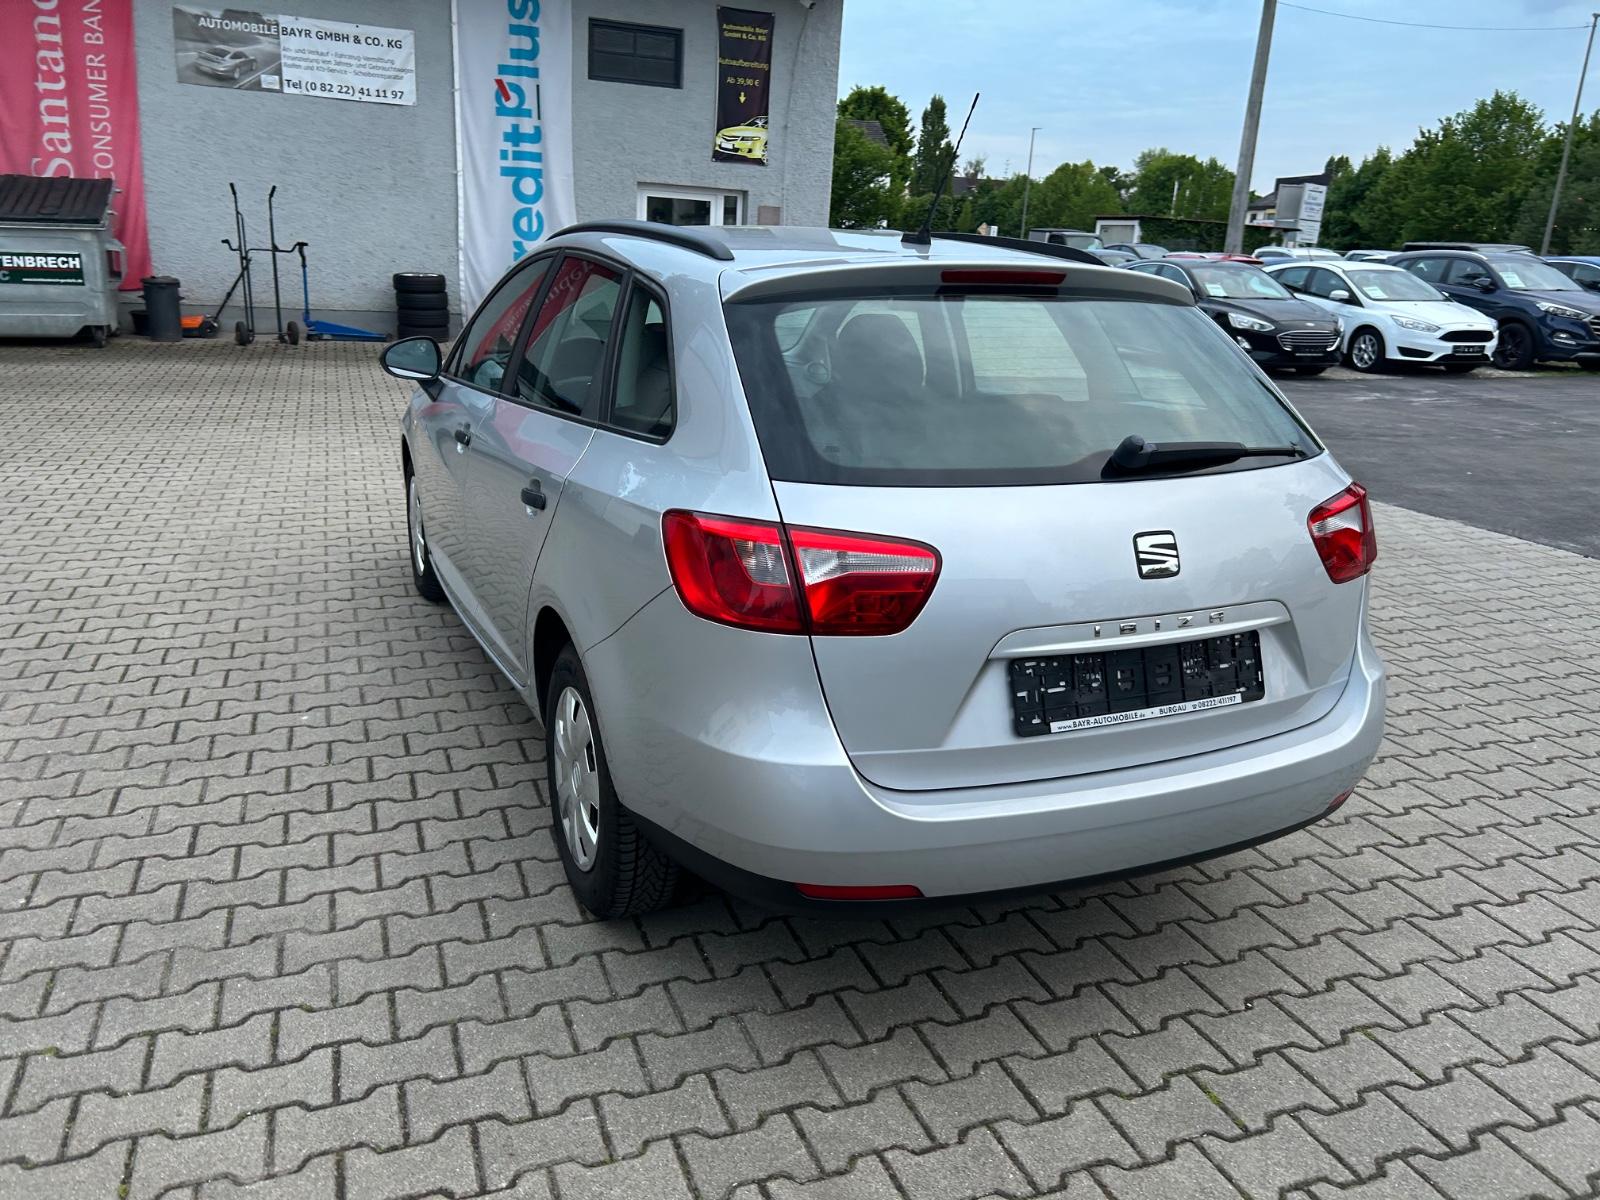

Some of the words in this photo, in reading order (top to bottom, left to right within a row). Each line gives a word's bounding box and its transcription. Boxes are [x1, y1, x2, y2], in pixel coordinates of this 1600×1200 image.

[198, 17, 278, 35] AUTOMOBILE
[281, 26, 312, 39] BAYR
[316, 30, 350, 43] GMBH
[353, 35, 362, 45] &
[365, 36, 384, 47] CO.
[387, 39, 403, 49] KG
[285, 79, 302, 90] Tel
[305, 80, 317, 93] (0
[320, 82, 334, 93] 82
[337, 84, 355, 96] 22)
[358, 87, 372, 97] 41
[376, 89, 388, 99] 11
[391, 90, 405, 100] 97
[754, 79, 760, 87] €
[0, 256, 80, 269] ENBRECH
[1159, 703, 1187, 716] BURGAU
